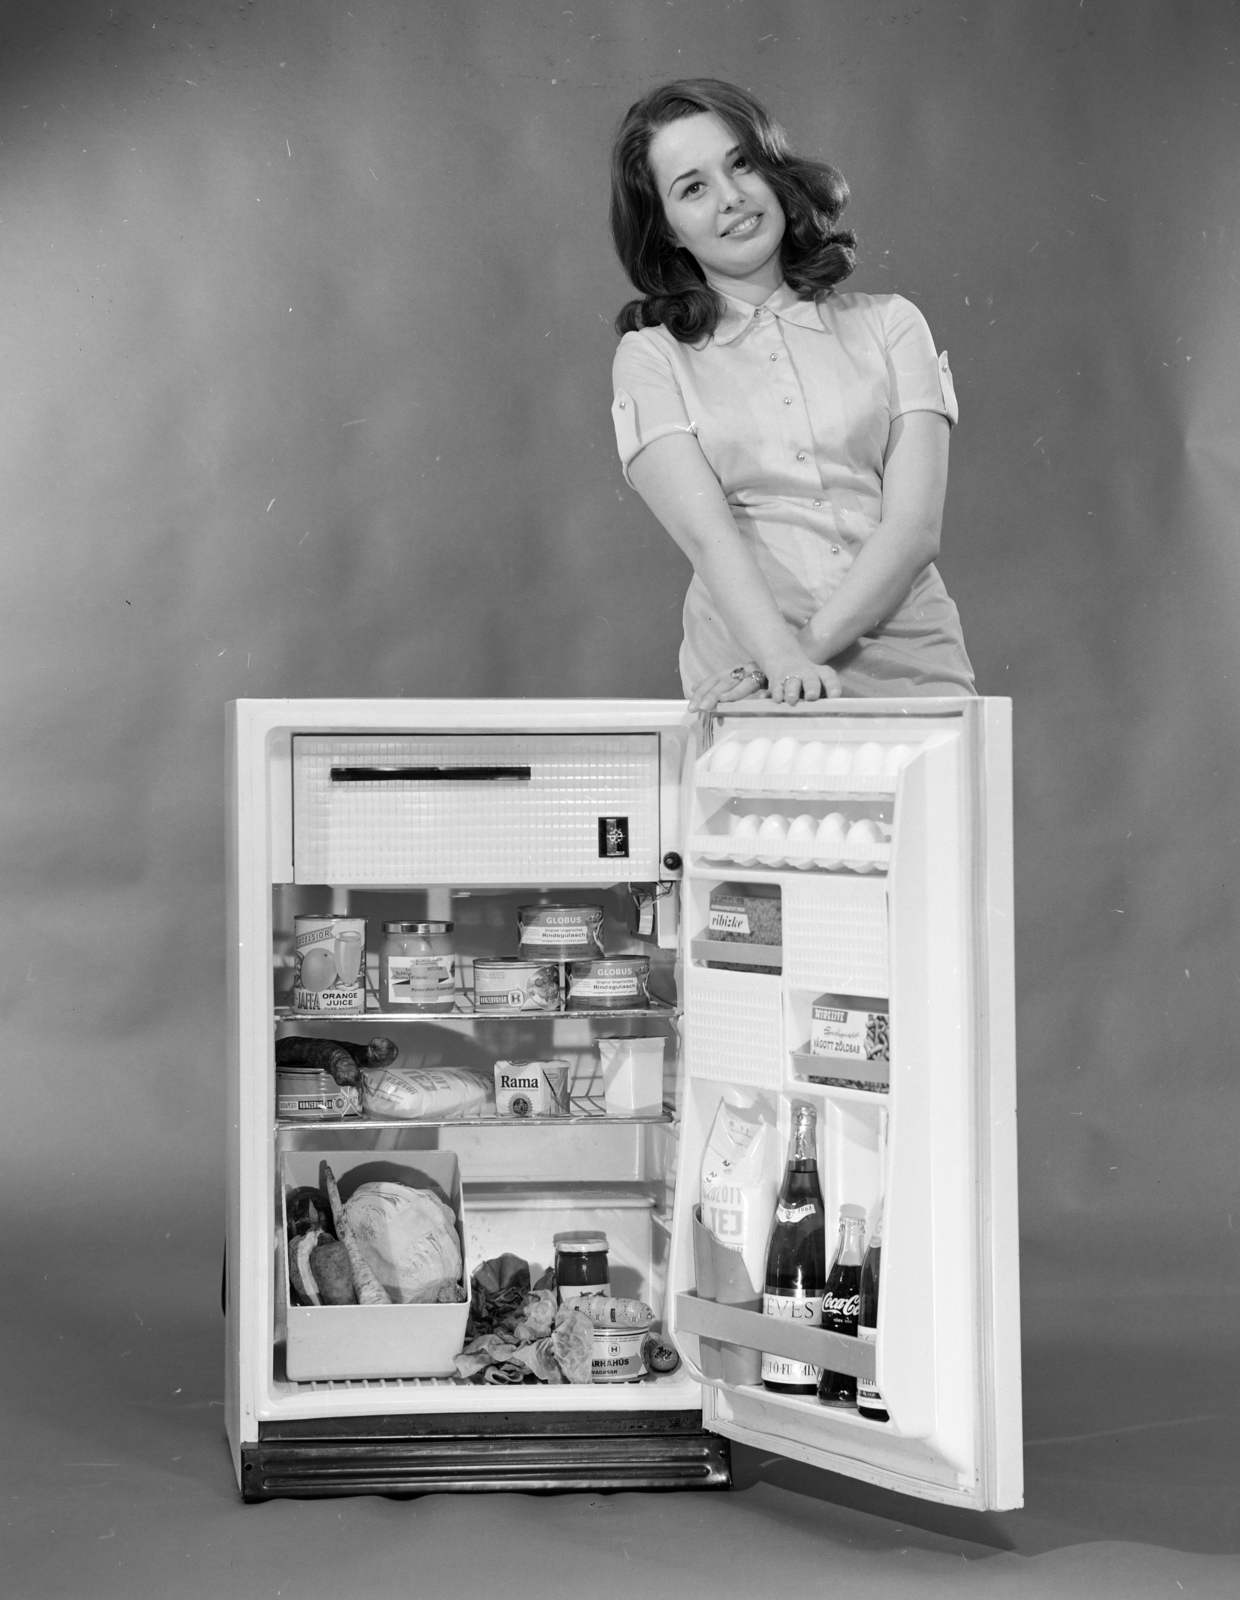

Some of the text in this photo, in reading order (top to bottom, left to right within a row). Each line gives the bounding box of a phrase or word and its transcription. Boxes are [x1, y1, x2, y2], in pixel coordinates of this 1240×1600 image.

[546, 916, 582, 924] GLOBUS
[712, 914, 744, 928] ribizke
[597, 967, 632, 976] GLOBUS
[813, 1037, 834, 1050] VÁGOTT
[834, 1040, 860, 1054] ZÖLDBAB
[401, 1070, 438, 1092] TEJ
[500, 1075, 540, 1089] Rama
[709, 1207, 742, 1236] TEJ
[766, 1296, 814, 1319] ÉVES
